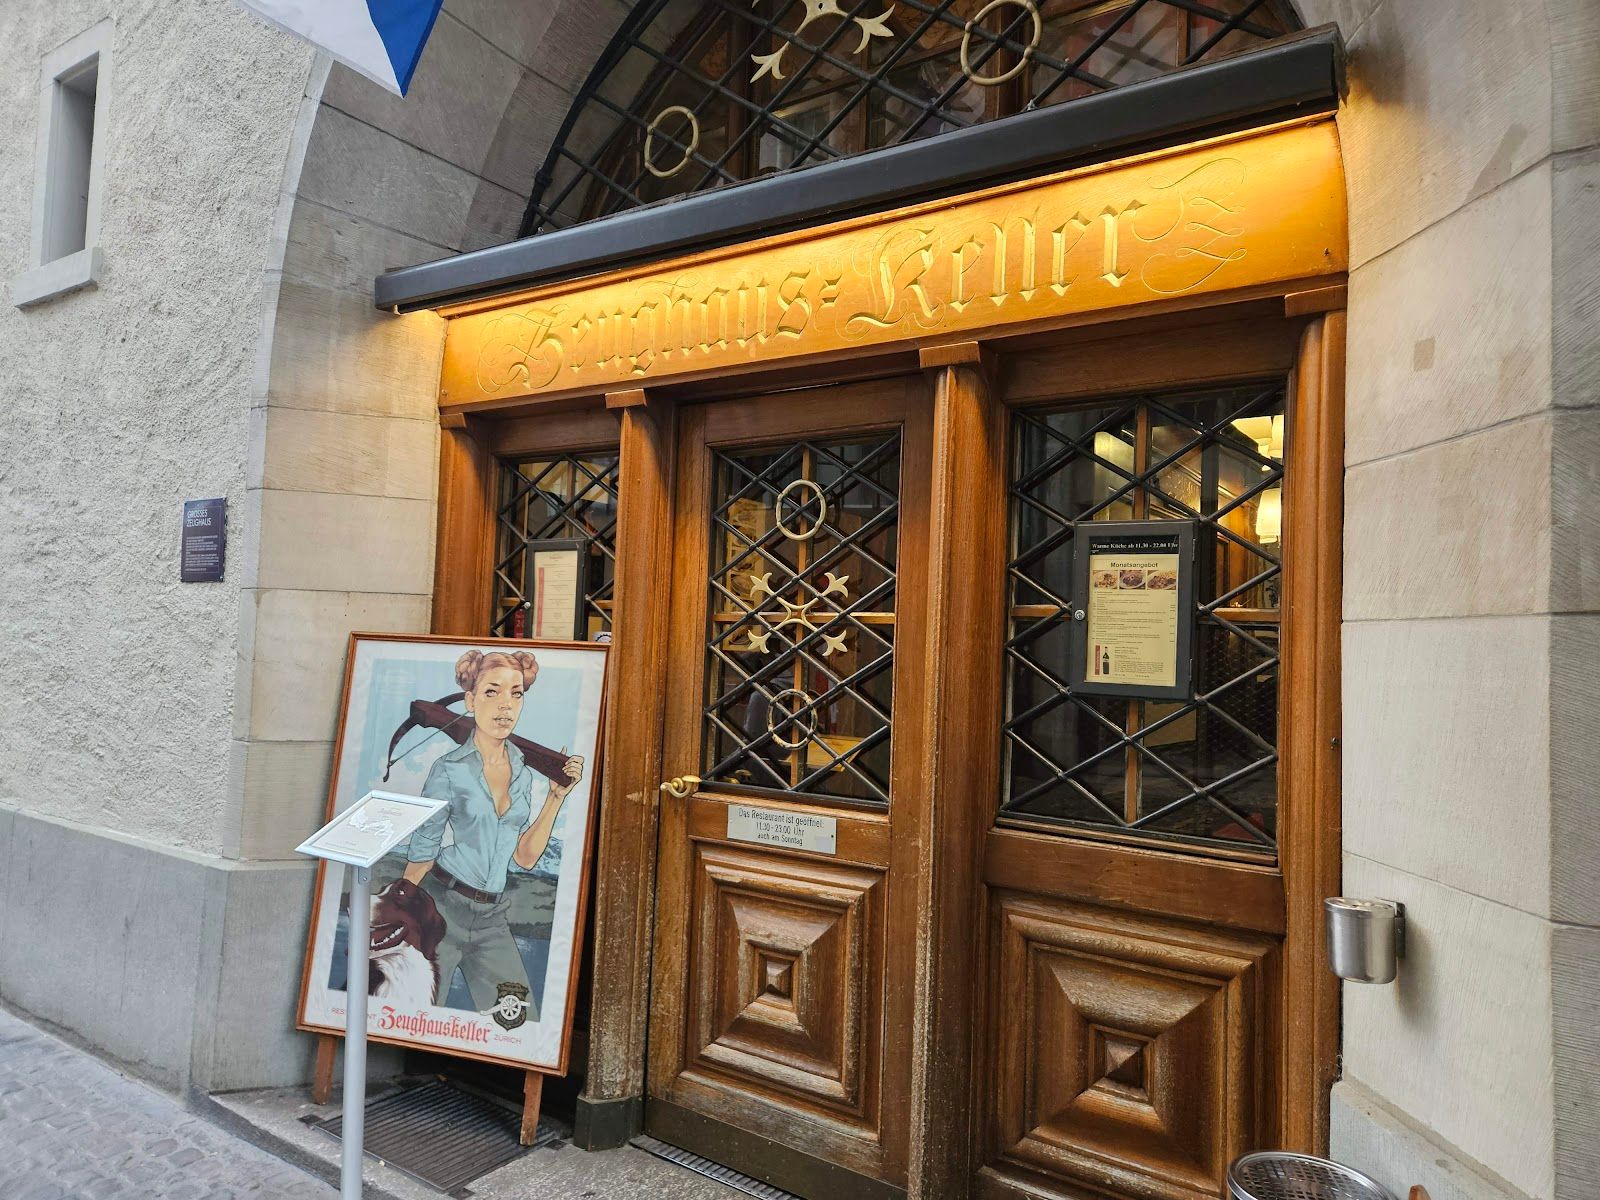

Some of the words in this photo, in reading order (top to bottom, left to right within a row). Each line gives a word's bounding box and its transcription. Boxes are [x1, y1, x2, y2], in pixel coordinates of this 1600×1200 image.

[188, 509, 208, 518] GROSSES
[187, 518, 211, 527] ZEUGHAUS
[738, 807, 750, 818] Das
[751, 809, 785, 823] Restaurant
[785, 814, 794, 824] ist
[793, 826, 805, 836] Uhr
[781, 834, 803, 846] Sonntag
[379, 1006, 492, 1042] Zeughauskeller
